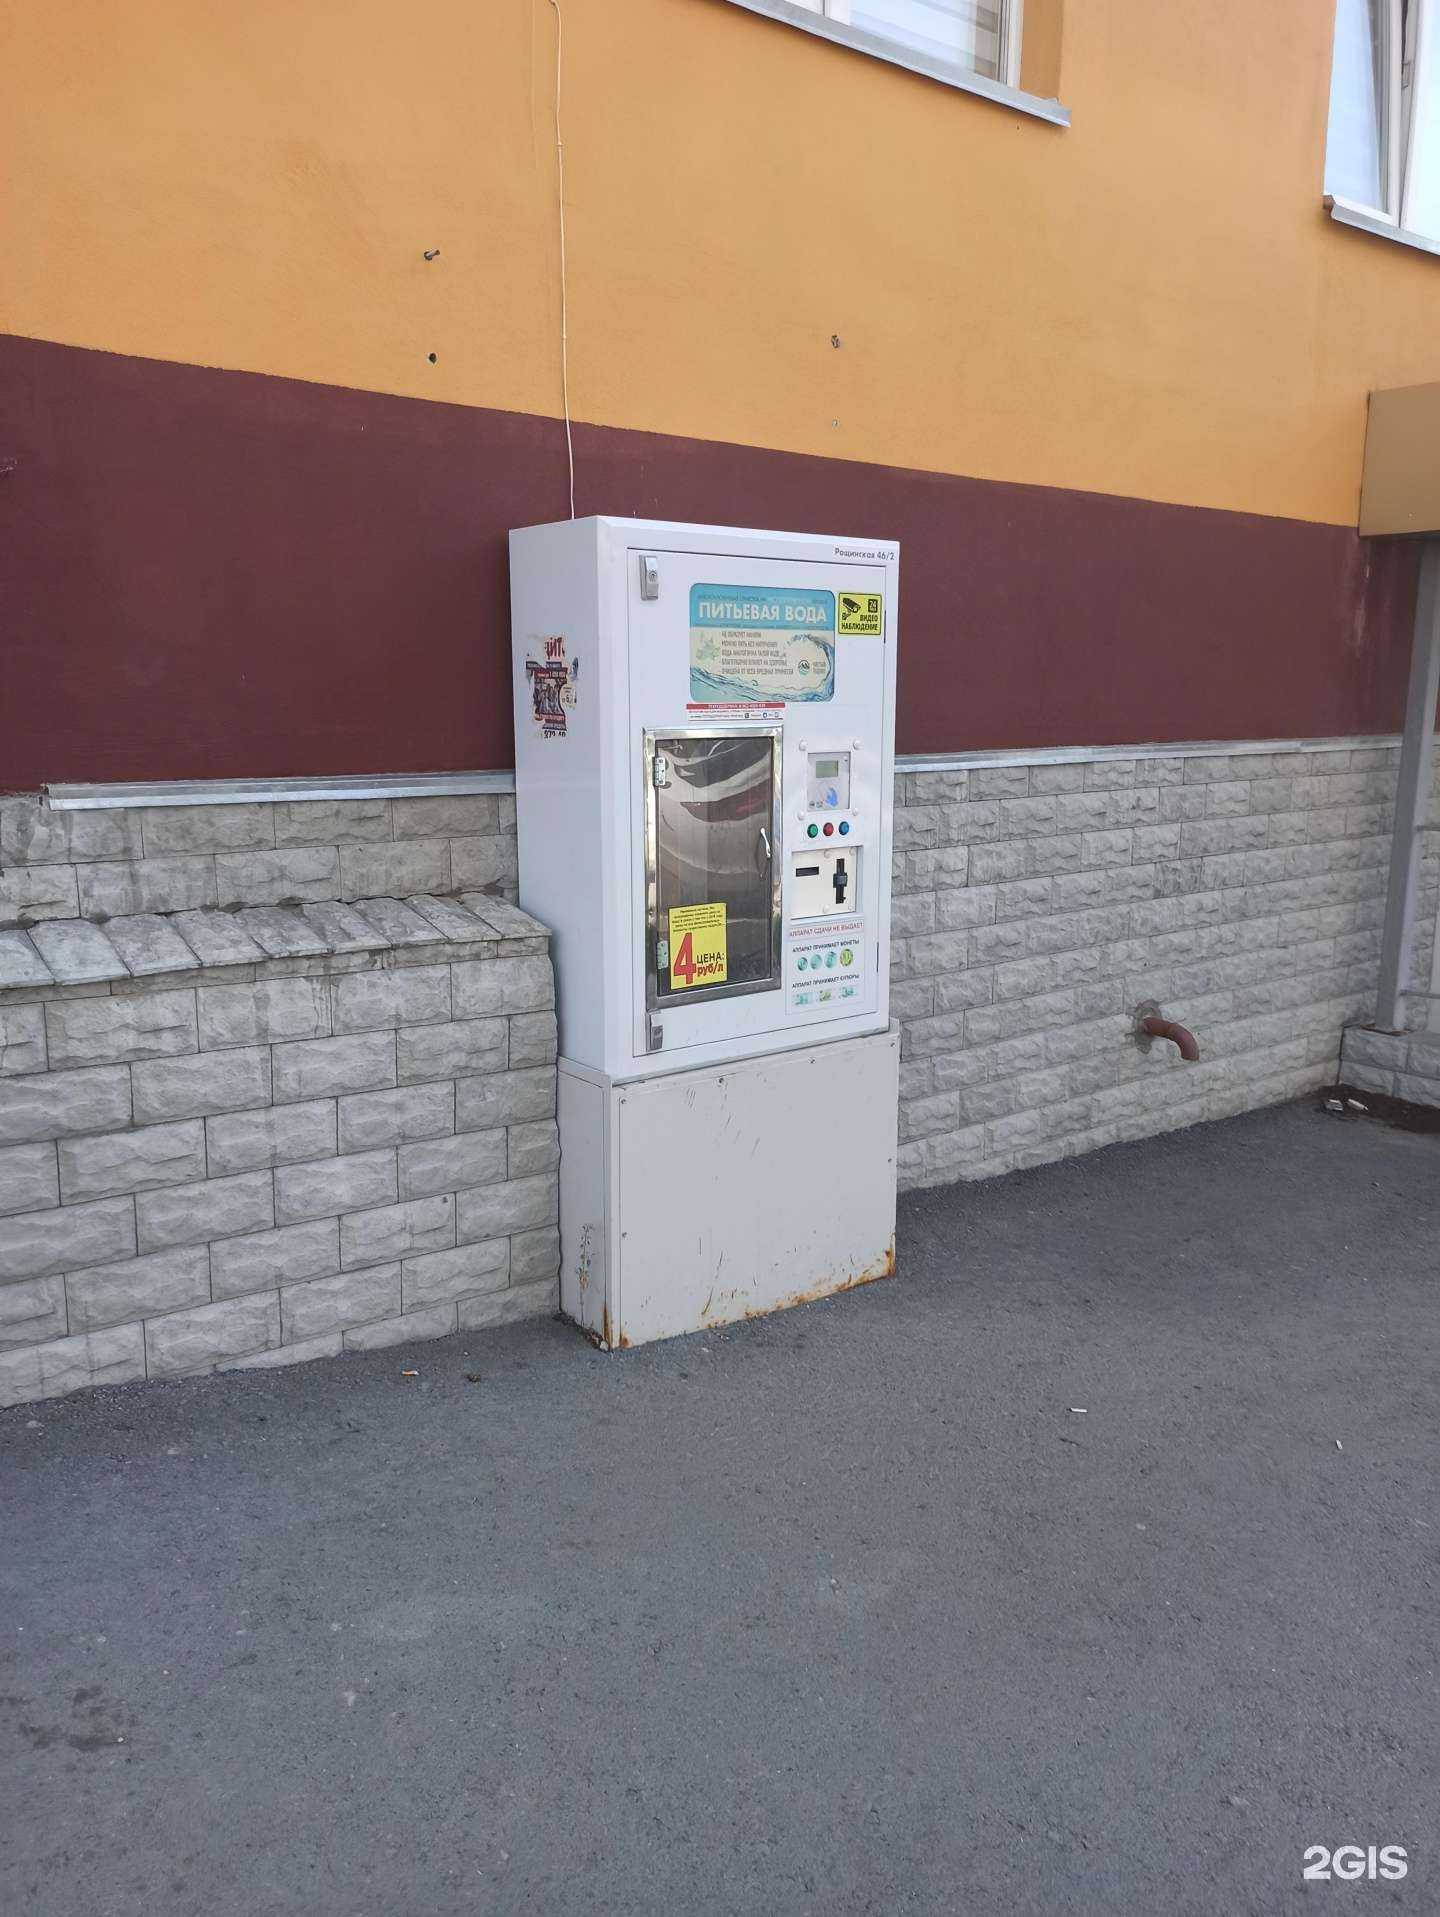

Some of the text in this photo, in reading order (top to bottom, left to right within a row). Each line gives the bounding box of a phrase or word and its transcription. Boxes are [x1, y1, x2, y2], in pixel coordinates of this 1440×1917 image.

[876, 552, 895, 560] 46/2
[699, 602, 828, 623] ПИТЬЕВАЯ ВОДА
[860, 614, 878, 623] ВИДЕО
[841, 622, 878, 631] НАБЛЮДЕНИЕ
[790, 929, 813, 937] АППАРАТ
[813, 926, 832, 934] СДАЧИ
[674, 932, 725, 984] 4 ЦЕНА:
[697, 962, 724, 976] руб/л
